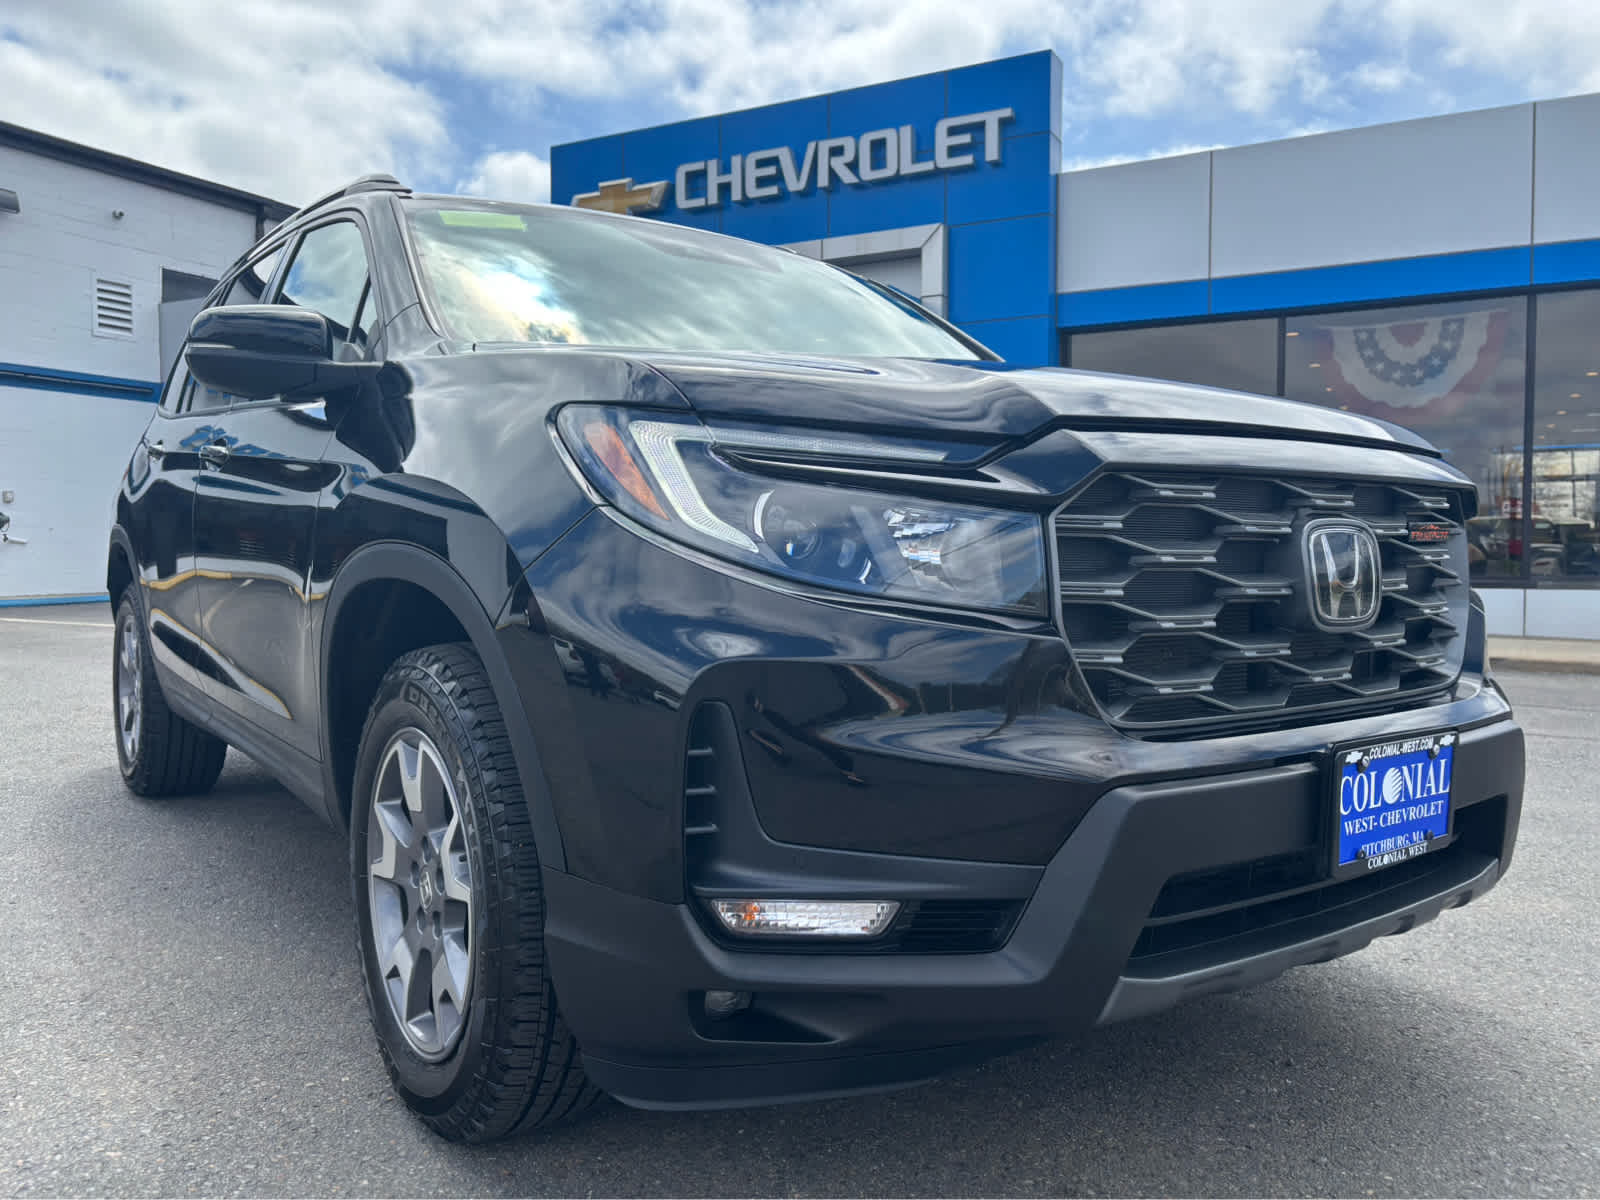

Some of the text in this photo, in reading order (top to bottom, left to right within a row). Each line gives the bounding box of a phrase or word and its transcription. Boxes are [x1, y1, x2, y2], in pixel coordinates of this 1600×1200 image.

[675, 107, 1015, 210] CHEVROLET
[1340, 758, 1450, 815] COLONIAL
[1380, 800, 1444, 828] CHEVROLET
[1368, 842, 1428, 869] COLONIAL WEST
